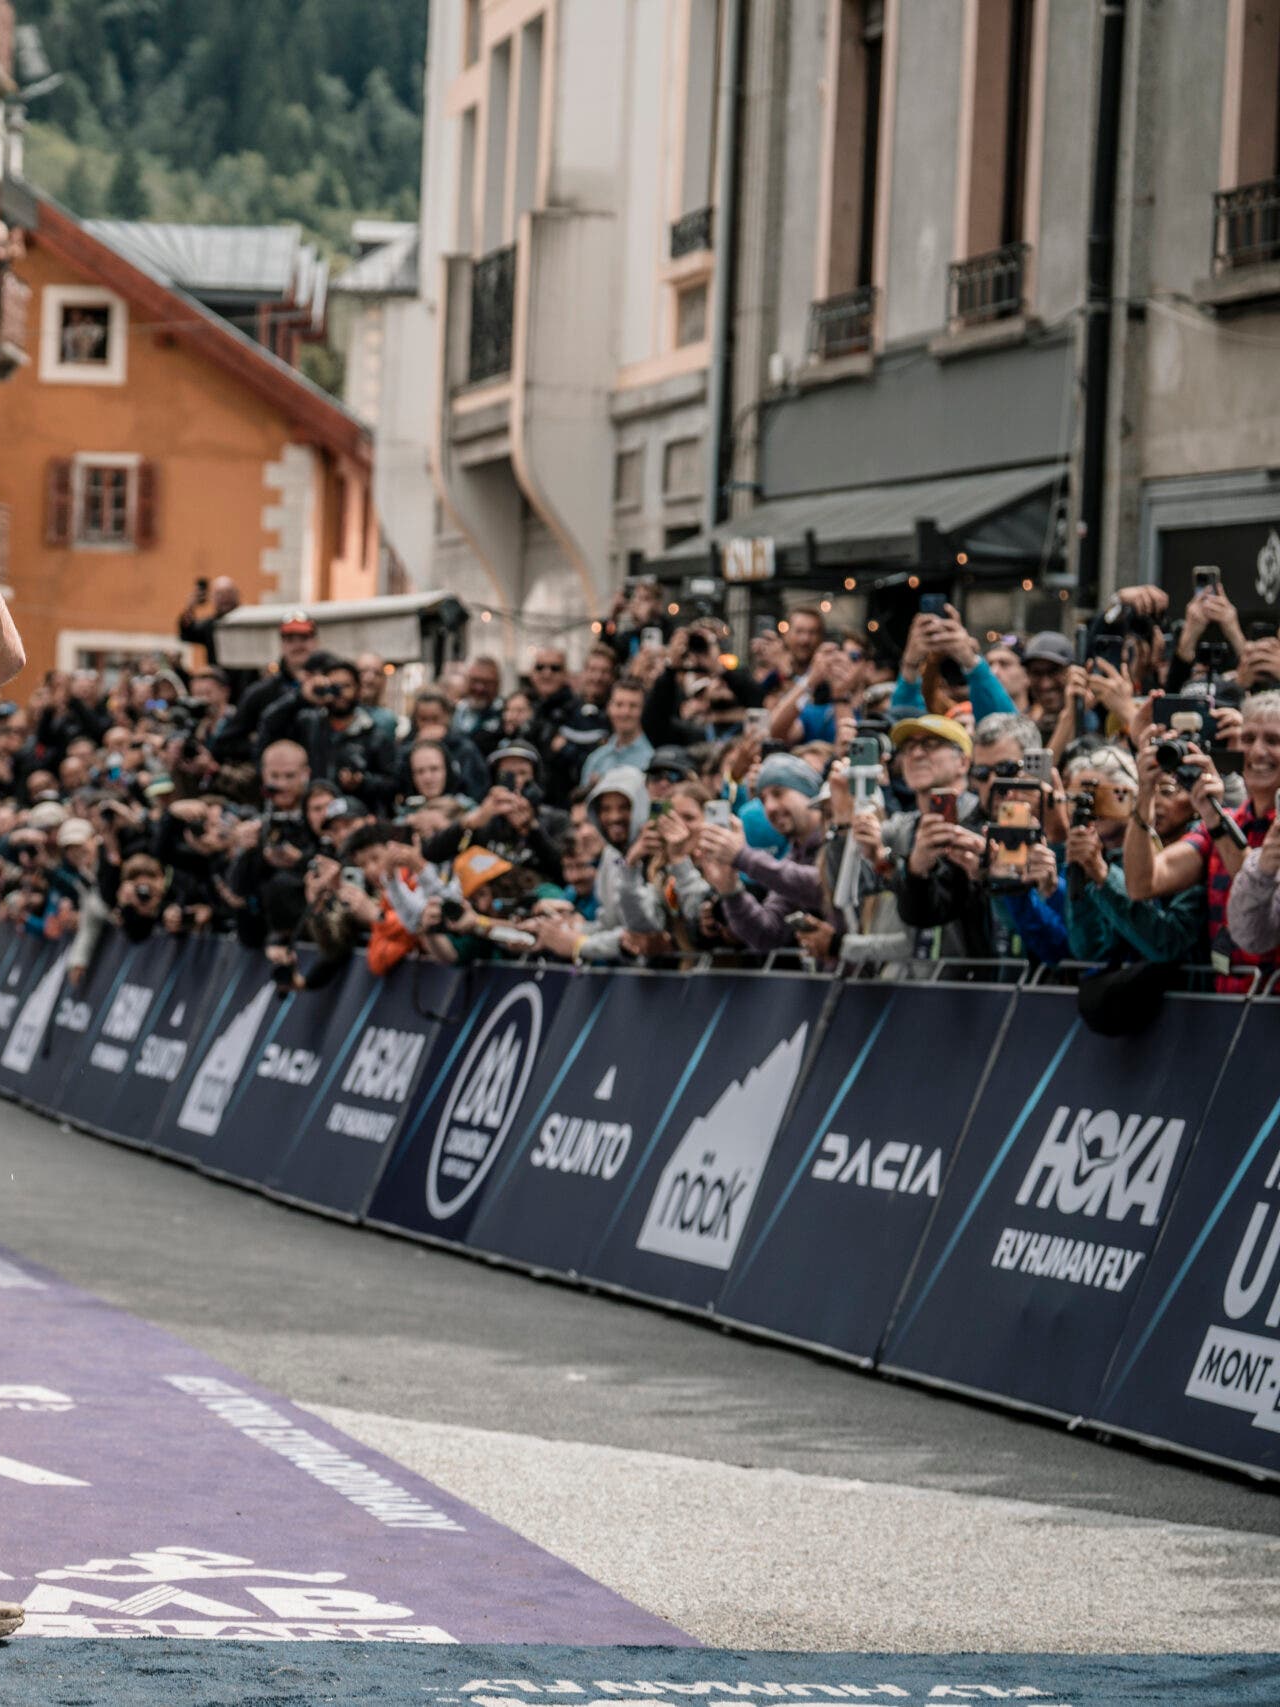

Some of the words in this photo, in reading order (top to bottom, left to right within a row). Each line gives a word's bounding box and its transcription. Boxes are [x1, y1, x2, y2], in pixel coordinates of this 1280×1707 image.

[531, 1112, 633, 1181] SUUNTO
[811, 1132, 942, 1197] DACIA
[1015, 1105, 1186, 1226] HOKA
[991, 1227, 1032, 1271] FLY
[1020, 1232, 1105, 1287] HUMAN
[1092, 1246, 1145, 1293] FLY
[1199, 1344, 1280, 1411] MONT-
[458, 1679, 586, 1693] FLY
[592, 1680, 910, 1697] HUMAN
